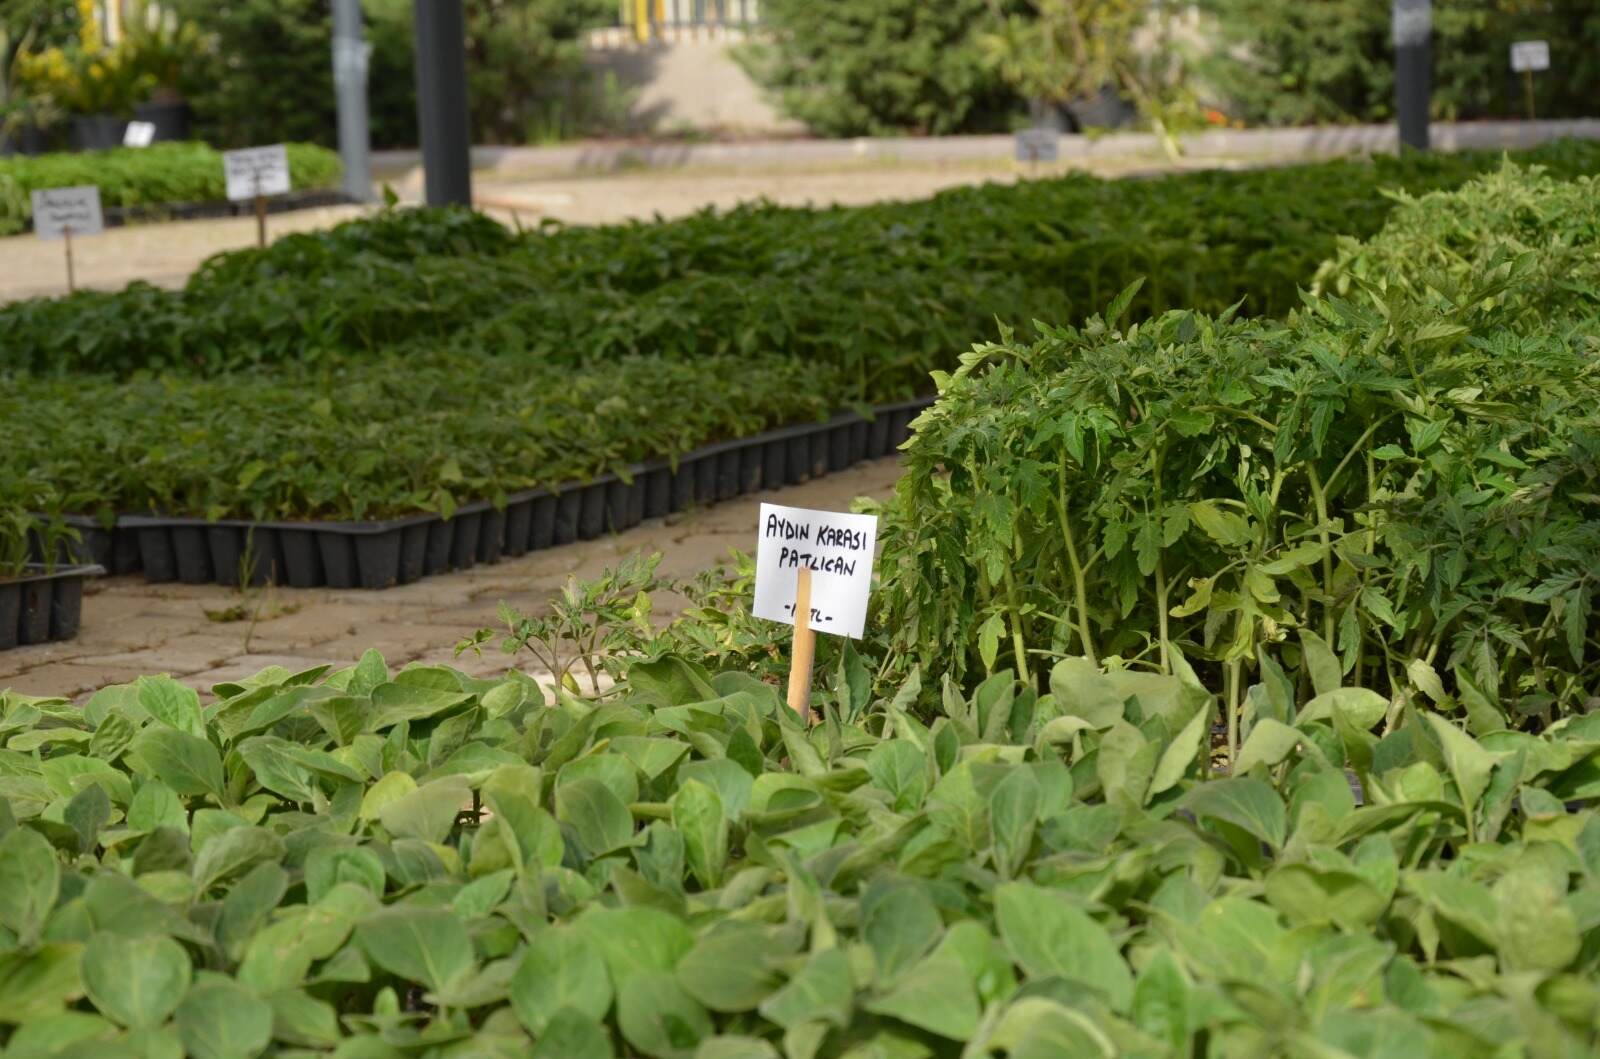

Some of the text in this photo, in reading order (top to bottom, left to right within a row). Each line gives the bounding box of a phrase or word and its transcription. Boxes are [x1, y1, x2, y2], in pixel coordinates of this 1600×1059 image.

[766, 513, 867, 550] AYDIN KARASI
[779, 546, 856, 576] PATLICAN
